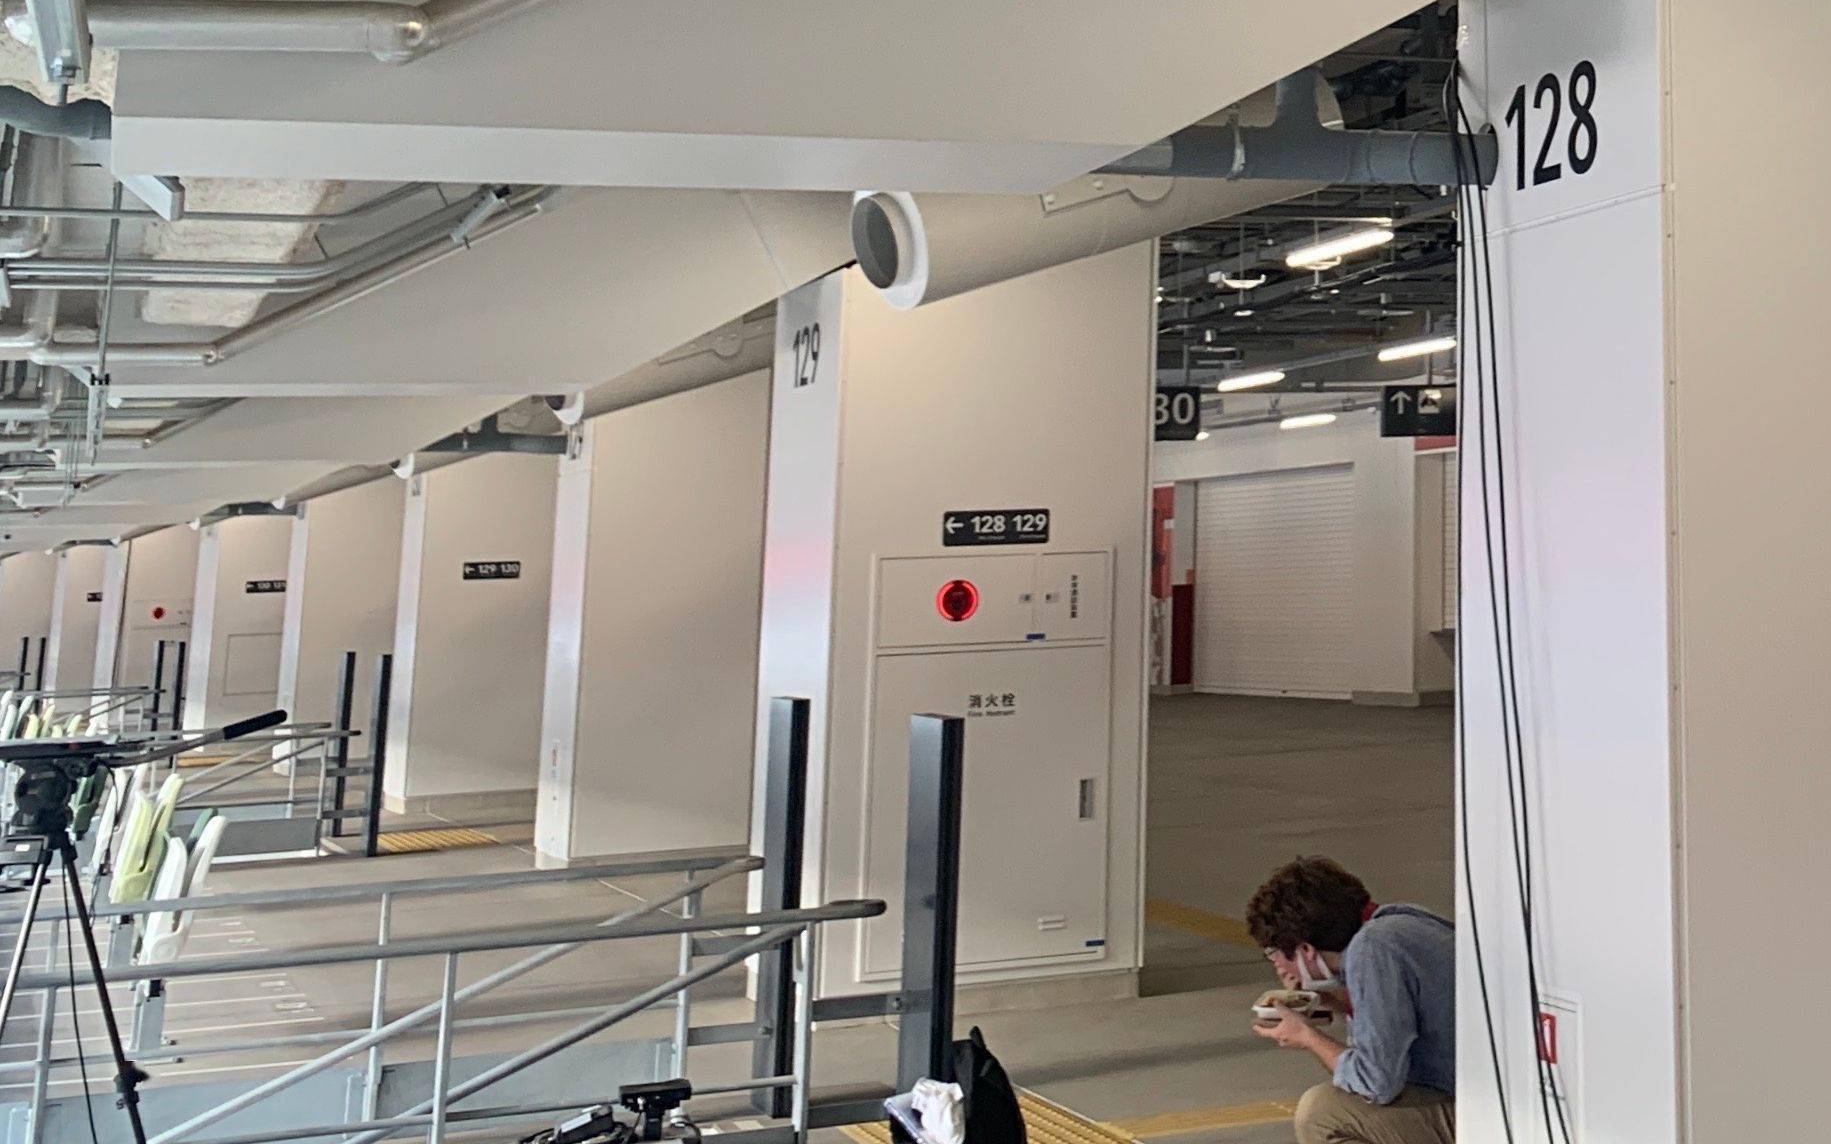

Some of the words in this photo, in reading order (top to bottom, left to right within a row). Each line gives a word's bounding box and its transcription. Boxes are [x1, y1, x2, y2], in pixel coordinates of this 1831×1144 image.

[1505, 60, 1598, 191] 128
[792, 322, 820, 389] 129
[970, 514, 1006, 533] 128
[1013, 513, 1047, 532] 129
[969, 692, 1016, 708] 消火栓
